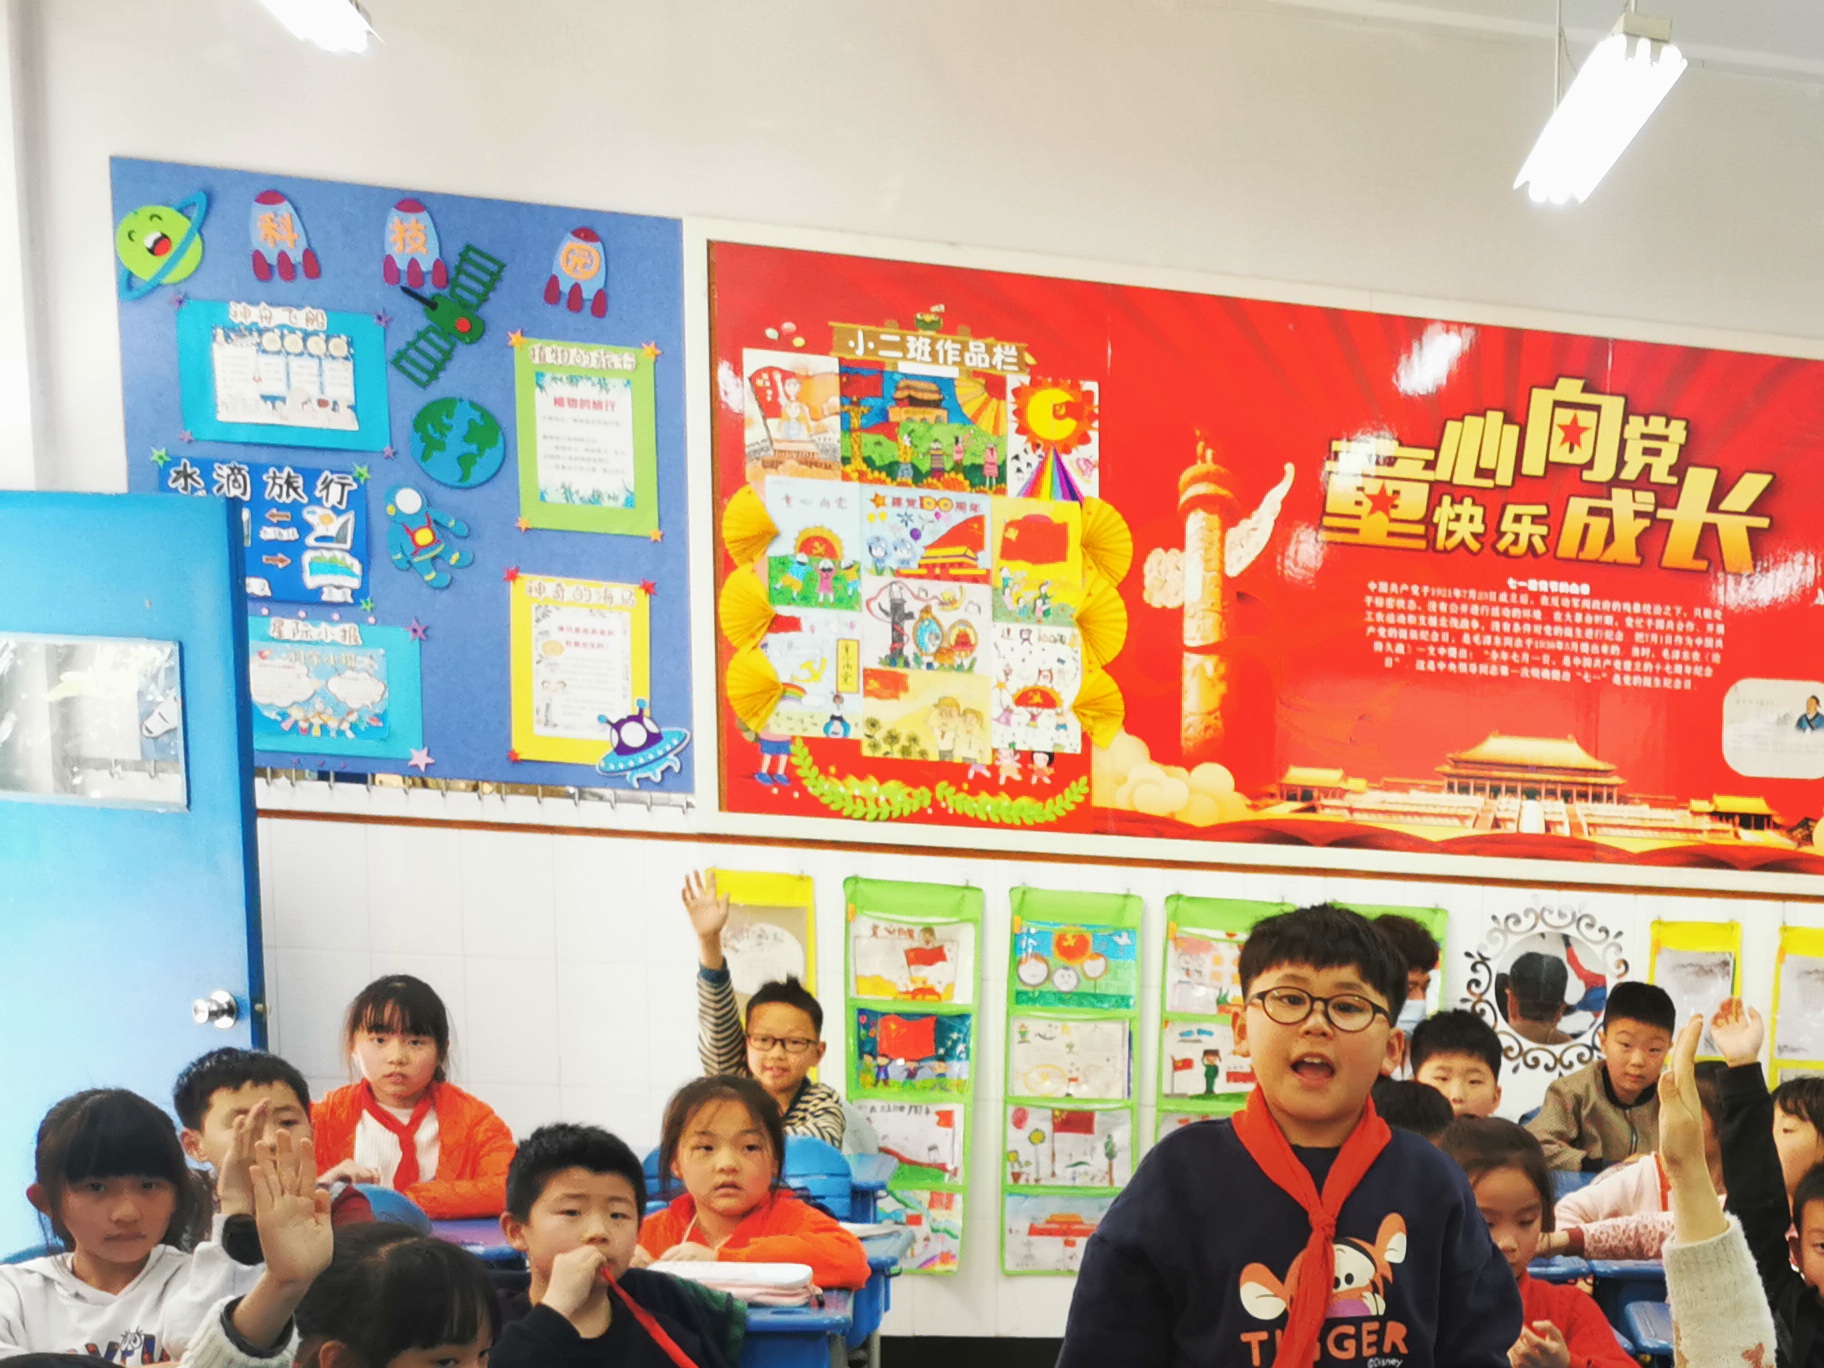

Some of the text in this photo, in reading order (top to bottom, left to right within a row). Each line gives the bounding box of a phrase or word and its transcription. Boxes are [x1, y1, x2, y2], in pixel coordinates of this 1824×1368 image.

[848, 328, 1020, 372] 小二班作品栏
[170, 461, 352, 507] 水滴旅行
[1322, 376, 1690, 550] 童心向党
[1430, 466, 1774, 575] 快乐成长
